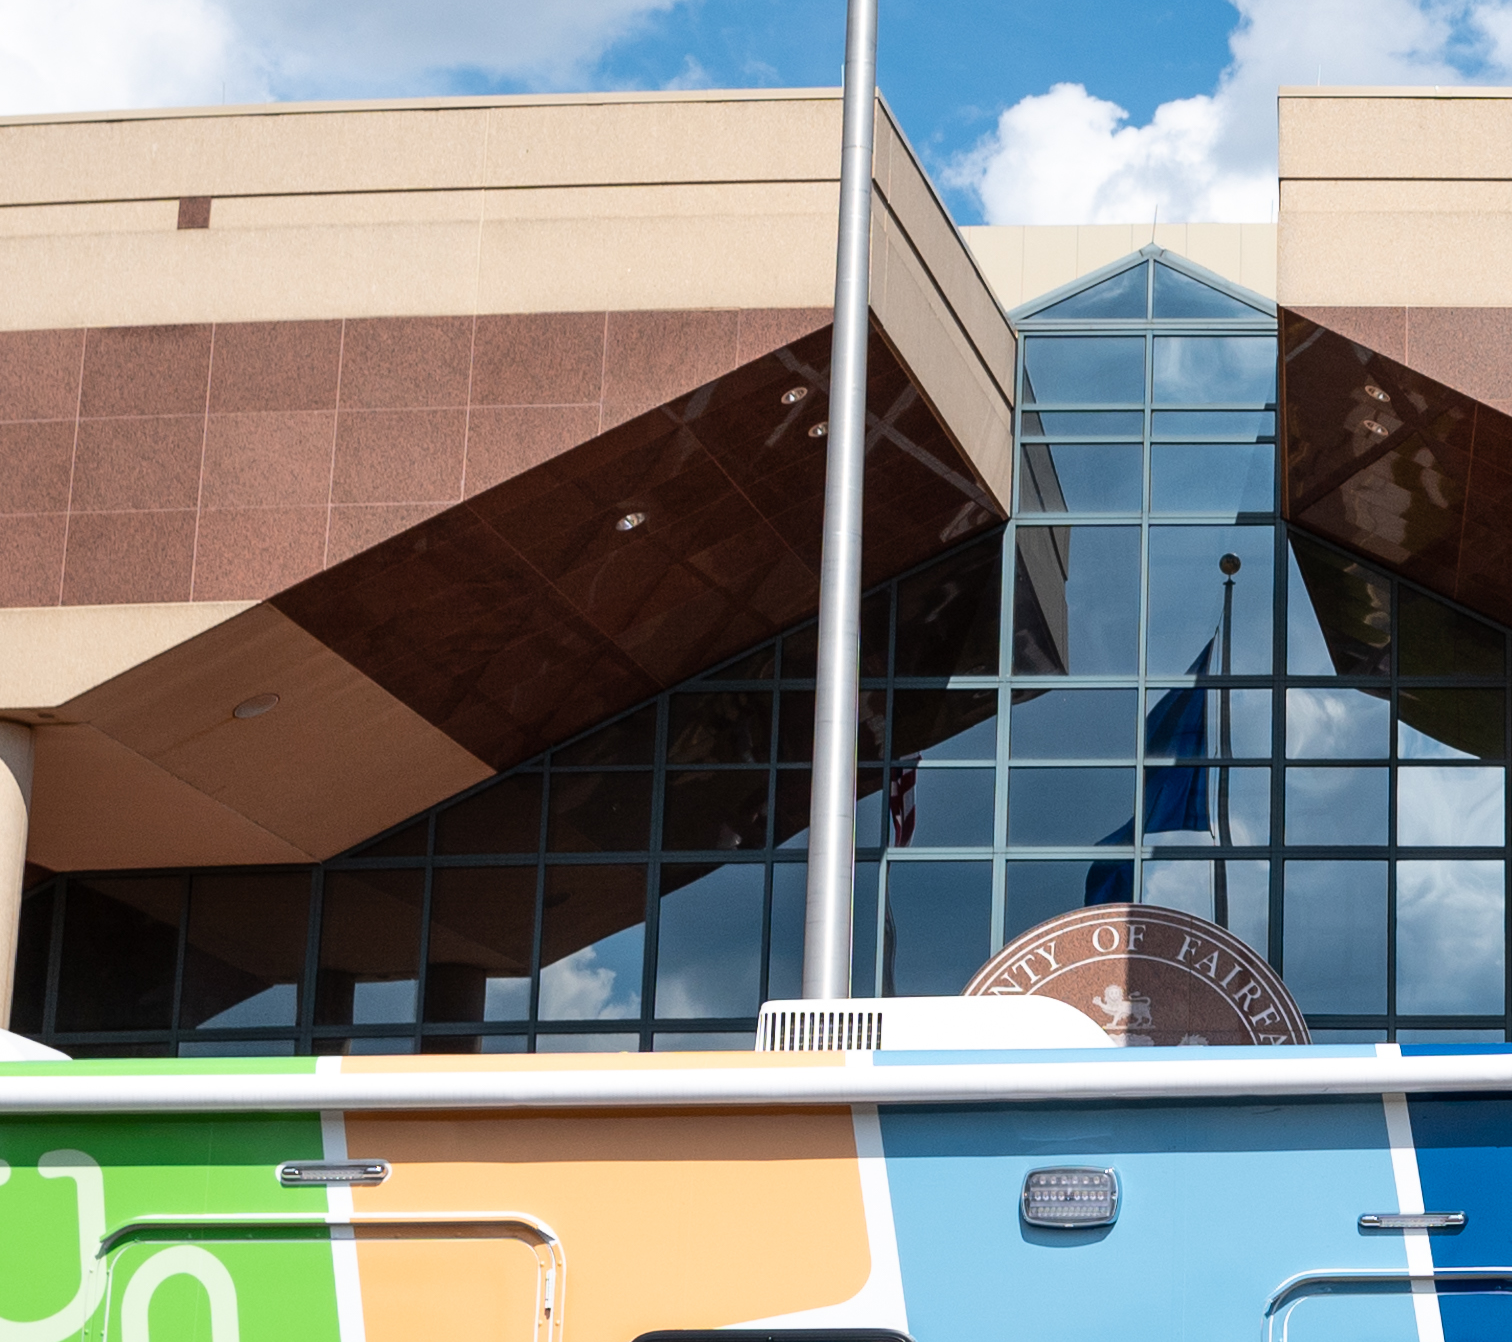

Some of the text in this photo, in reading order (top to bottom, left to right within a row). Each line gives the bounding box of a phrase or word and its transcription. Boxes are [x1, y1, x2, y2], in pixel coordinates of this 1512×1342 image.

[988, 924, 1288, 1046] NTY OF FAIRFA
